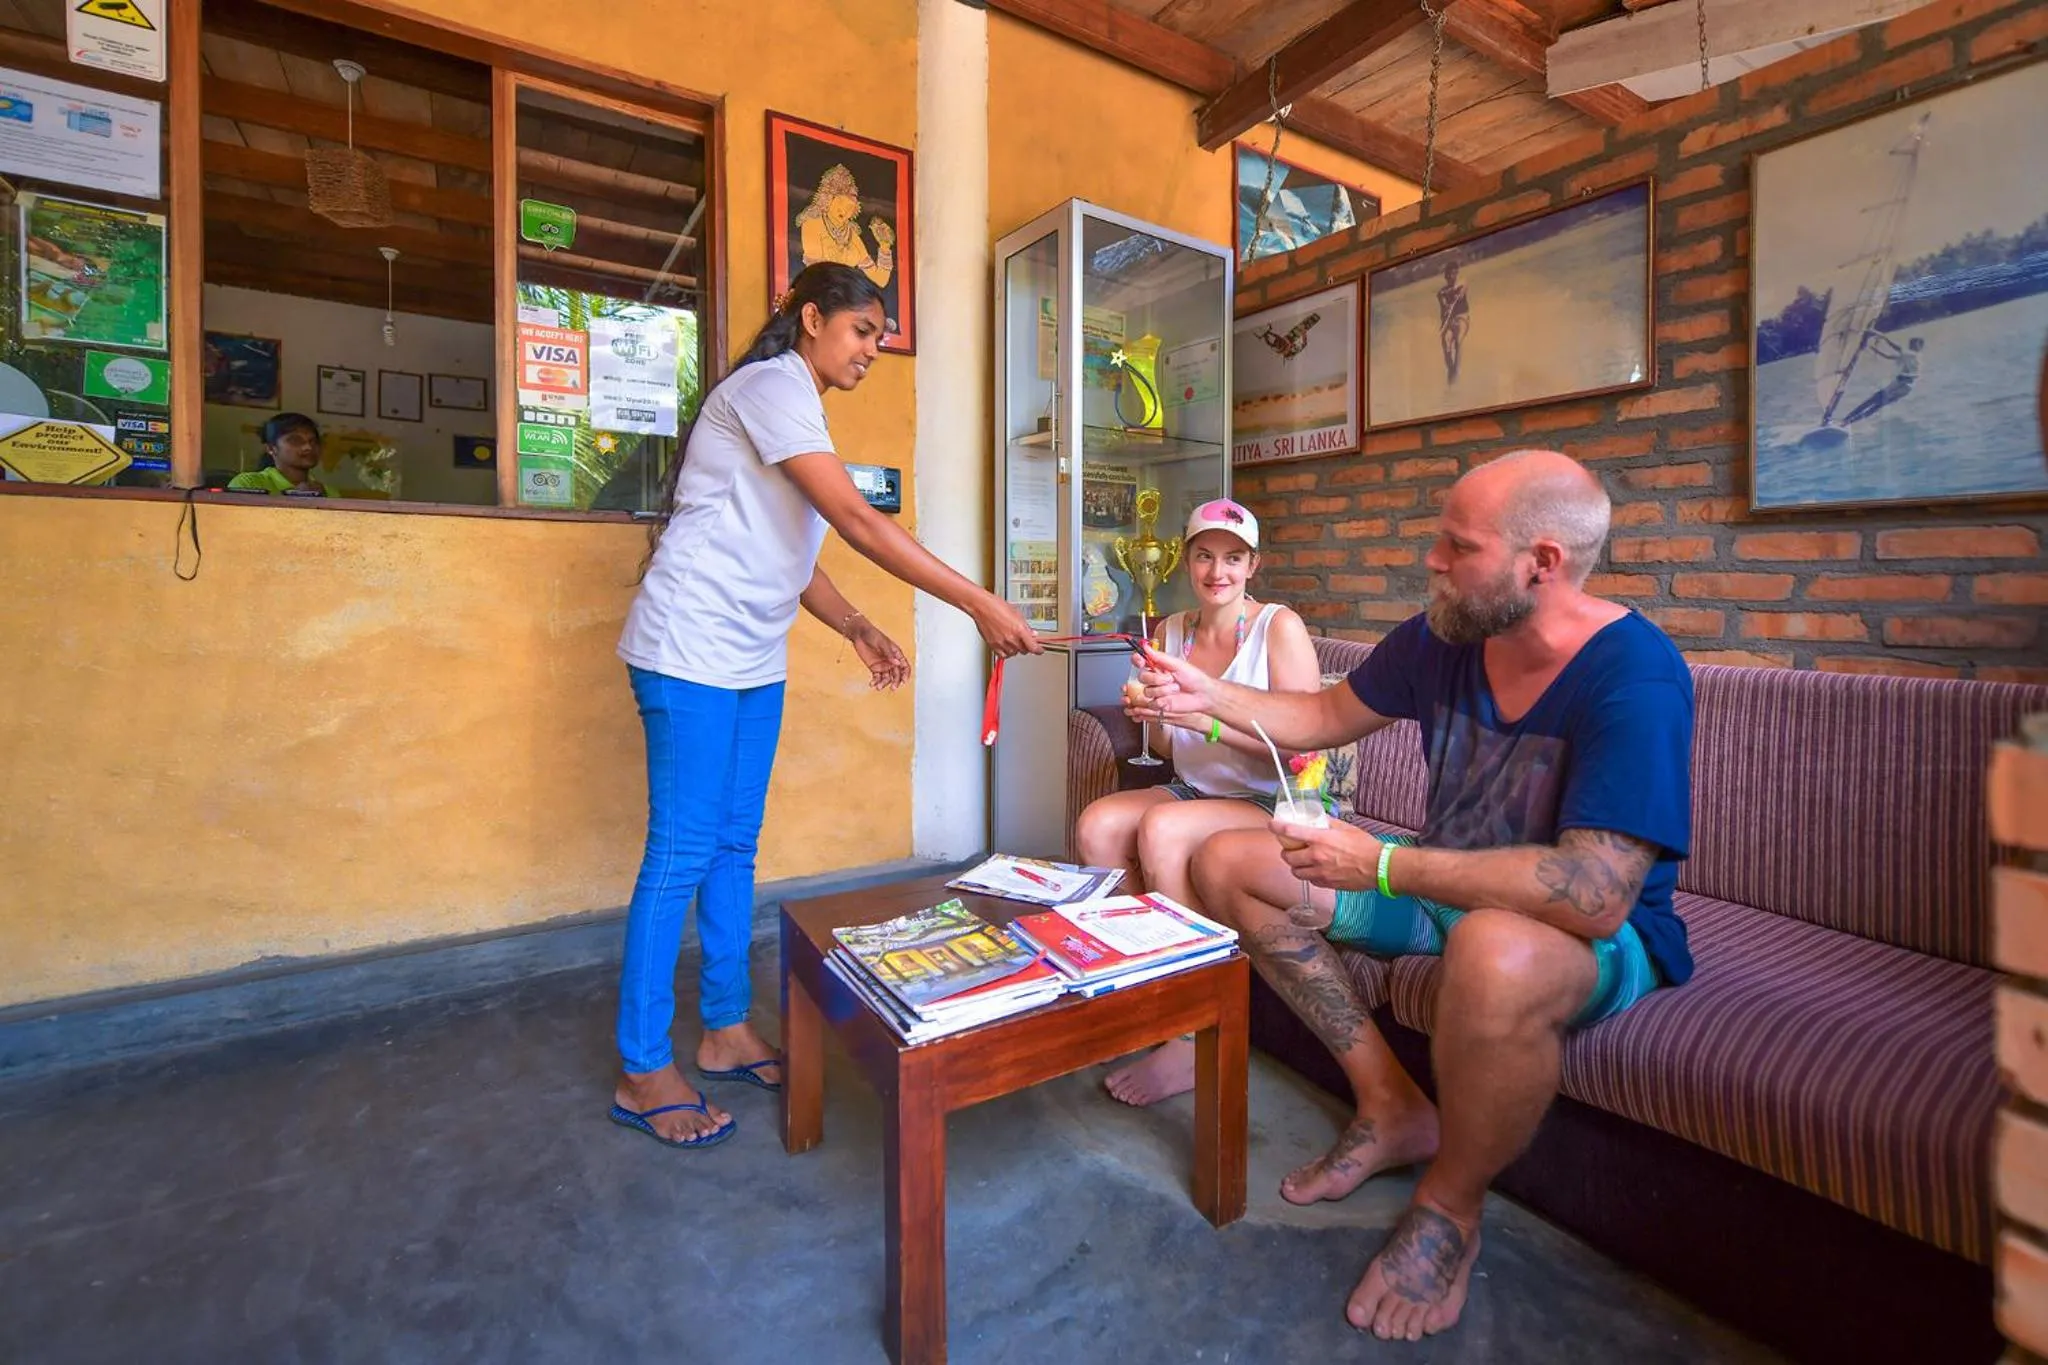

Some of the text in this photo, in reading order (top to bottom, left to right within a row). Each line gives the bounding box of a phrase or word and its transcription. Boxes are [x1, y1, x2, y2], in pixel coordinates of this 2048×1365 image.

[532, 345, 578, 364] VISA
[45, 425, 76, 434] Help
[119, 420, 145, 429] VISA
[35, 432, 84, 441] protect
[524, 431, 550, 442] WLAN
[1273, 436, 1294, 456] SRI
[1300, 428, 1348, 453] LANKA
[11, 441, 103, 454] Environment!
